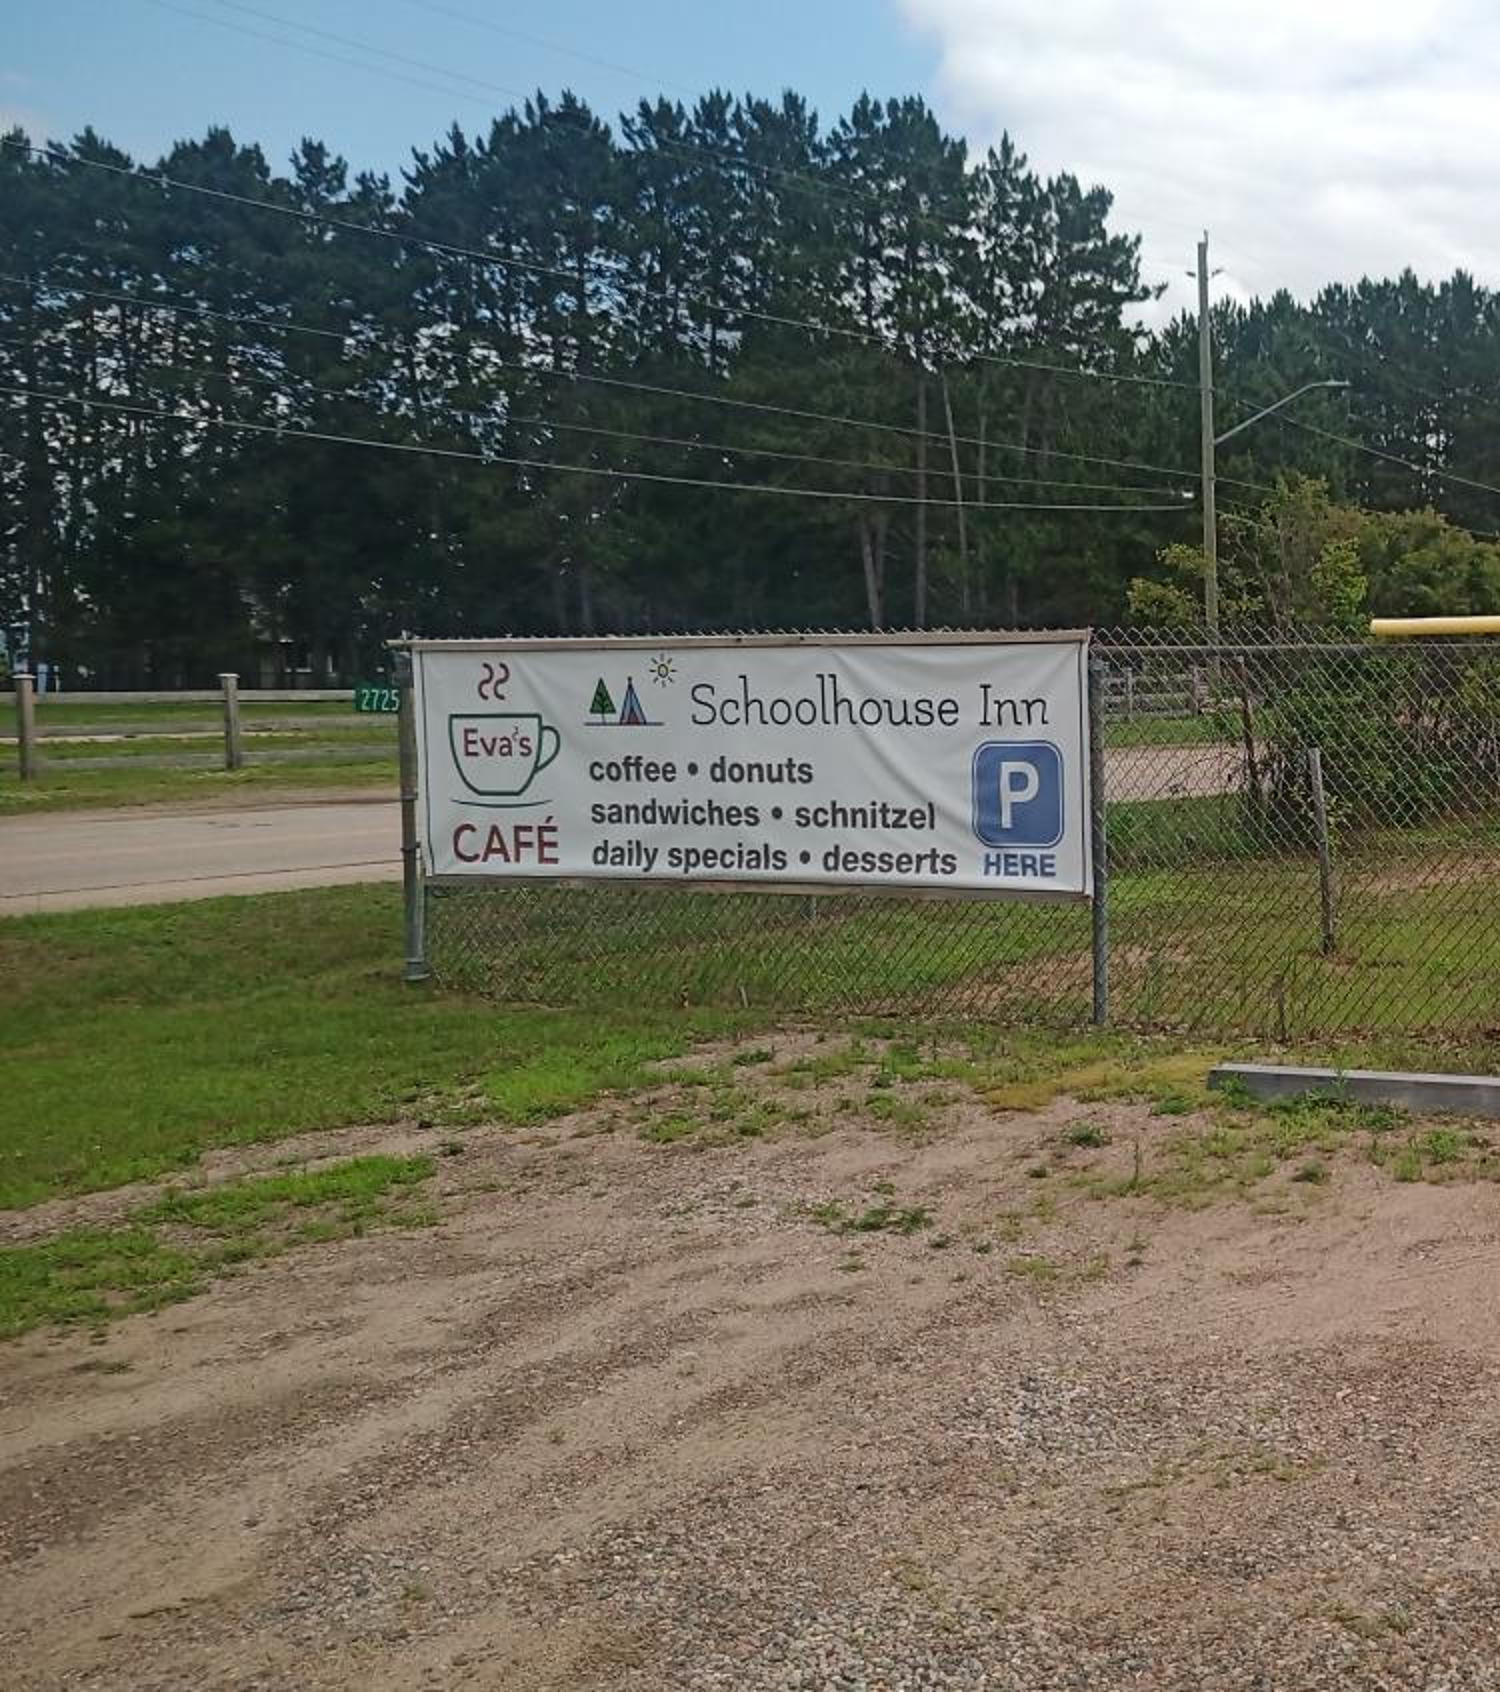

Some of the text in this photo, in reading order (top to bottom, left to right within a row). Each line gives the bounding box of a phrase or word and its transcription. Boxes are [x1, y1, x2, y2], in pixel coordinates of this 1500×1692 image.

[361, 689, 400, 711] 2725
[691, 674, 1049, 727] Schoolhouse Inn
[463, 725, 532, 757] Eva's
[589, 755, 814, 784] coffee donuts
[1000, 761, 1040, 829] P
[591, 798, 935, 831] sandwiches schnitzel
[453, 816, 560, 865] CAFÉ
[592, 839, 957, 875] daily specials desserts
[983, 853, 1057, 877] HERE
